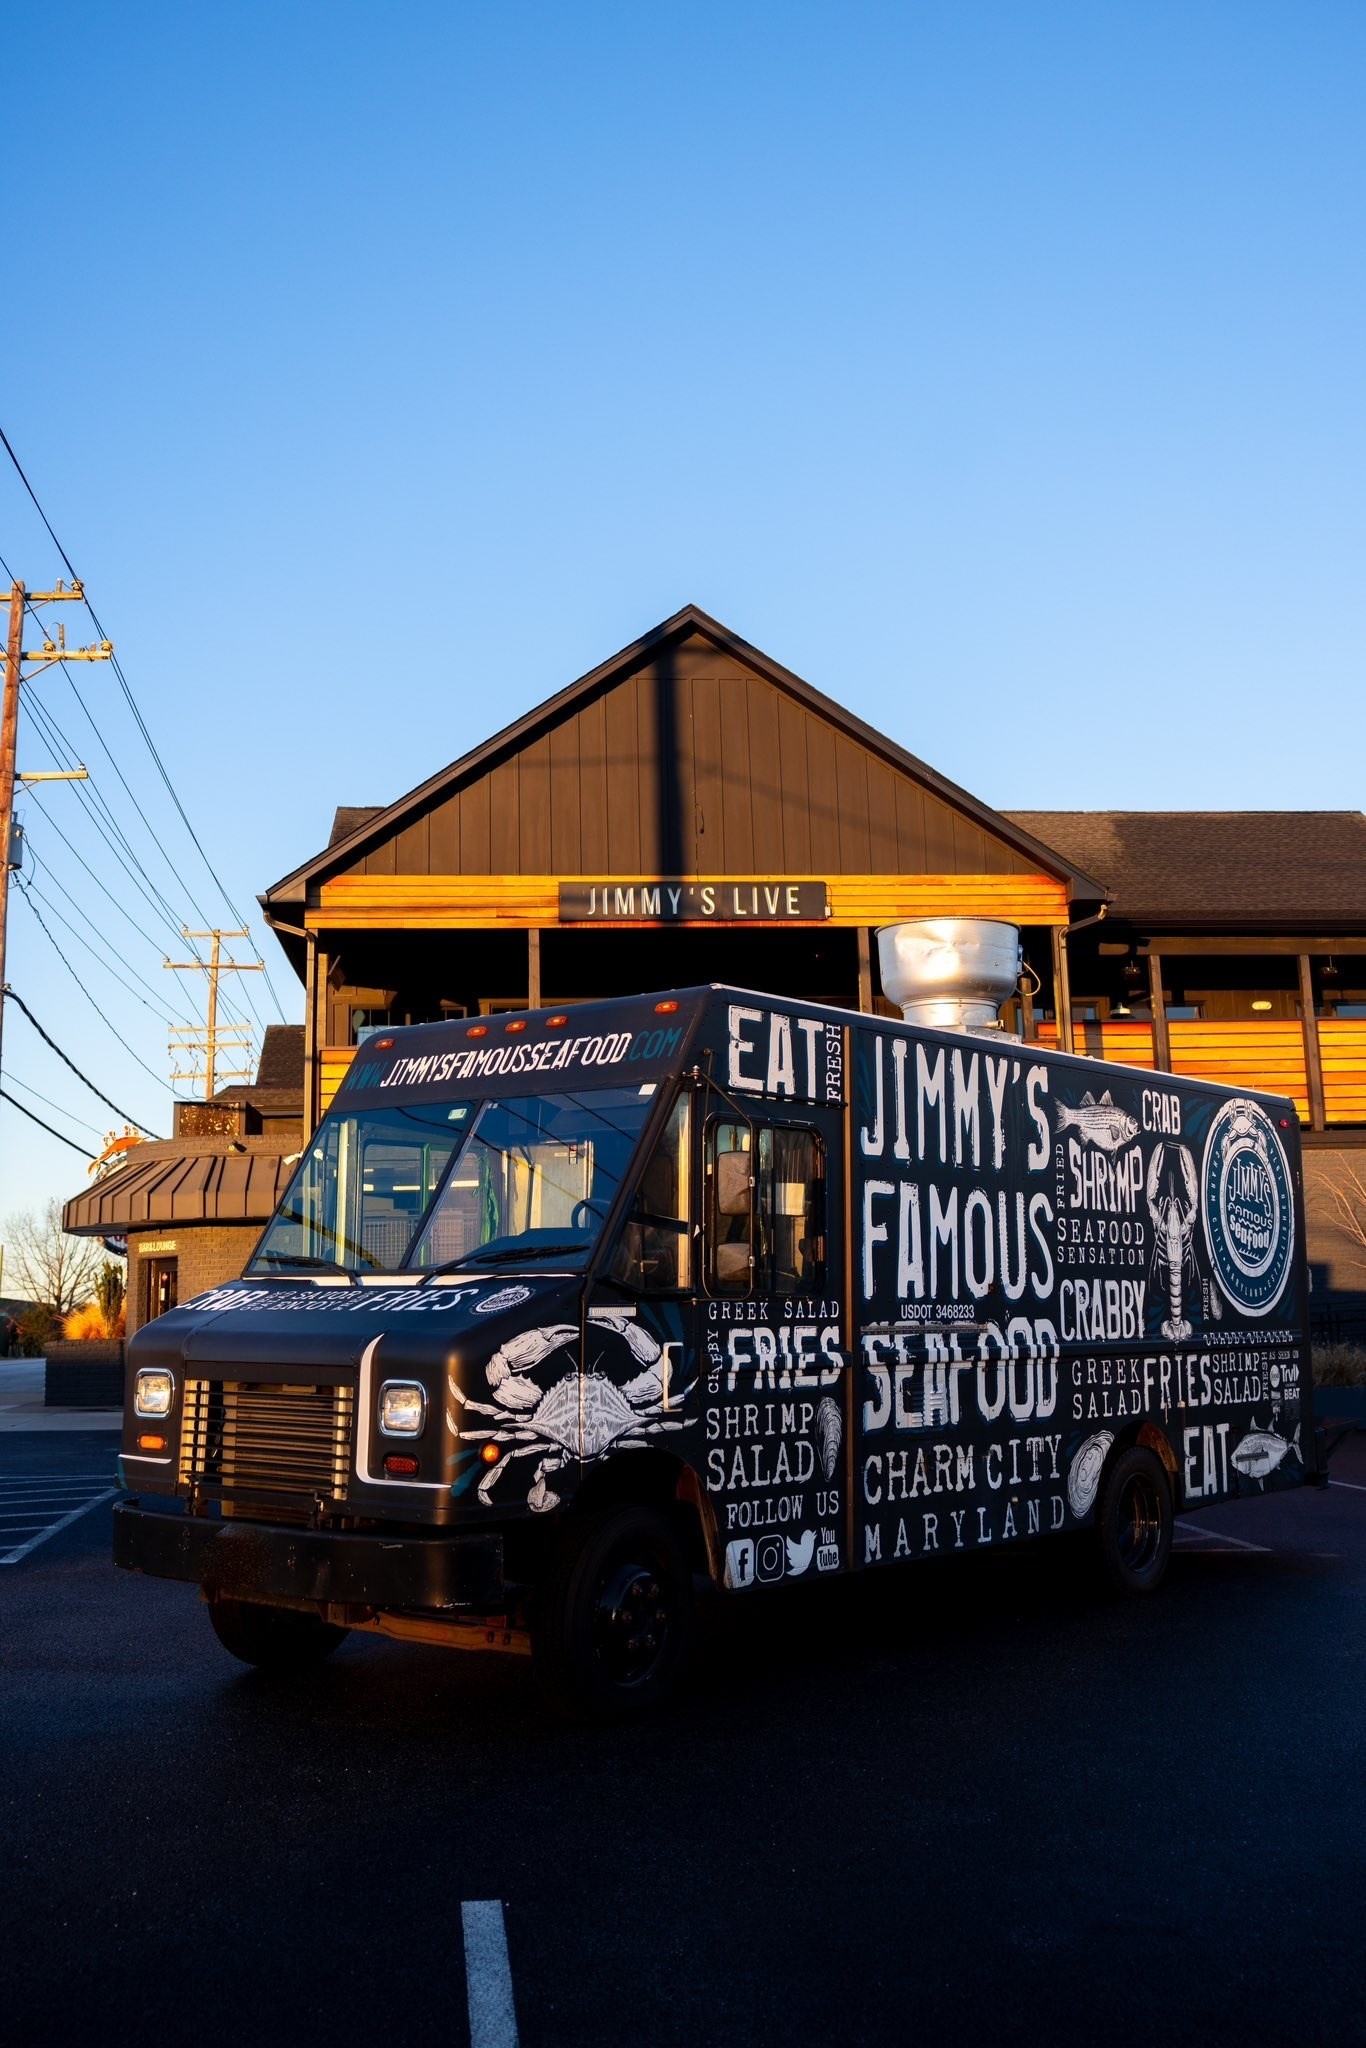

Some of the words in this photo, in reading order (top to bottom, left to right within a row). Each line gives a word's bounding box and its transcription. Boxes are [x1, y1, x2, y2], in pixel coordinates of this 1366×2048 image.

[587, 886, 716, 916] JIMMY'S
[732, 885, 801, 915] LIVE
[728, 1004, 824, 1101] EAT
[826, 1023, 842, 1102] FRESH
[860, 1035, 1050, 1173] JIMMY'S
[1142, 1089, 1181, 1136] CRAB
[1056, 1142, 1064, 1210] FRIED
[1068, 1137, 1144, 1214] SHRIMP
[1227, 1157, 1272, 1218] JIMMY'S
[861, 1179, 1055, 1300] FAMOUS
[1056, 1217, 1145, 1246] SEAFOOD
[1057, 1246, 1145, 1266] SENSATION
[174, 1289, 270, 1311] CRAB
[267, 1300, 343, 1311] ENJOY
[292, 1290, 362, 1300] SAVOR
[349, 1288, 479, 1311] FRIES
[708, 1301, 769, 1321] GREEK
[784, 1299, 840, 1320] SALAD
[901, 1304, 933, 1319] USDOT
[935, 1304, 975, 1319] 3468233
[1059, 1278, 1146, 1343] CRABBY
[727, 1325, 844, 1392] FRIES
[861, 1316, 1060, 1431] SEAFOOD
[1071, 1357, 1141, 1387] GREEK
[1212, 1351, 1260, 1374] SHRIMP
[1261, 1351, 1269, 1401] FRESH
[1143, 1354, 1212, 1413] FRIES
[1213, 1375, 1261, 1406] SALAD
[1284, 1387, 1301, 1401] BEAT
[705, 1402, 814, 1440] SHRIMP
[1072, 1389, 1142, 1420] SALAD
[706, 1440, 815, 1492] SALAD
[863, 1444, 977, 1506] CHARM
[986, 1434, 1062, 1490] CITY
[1183, 1422, 1230, 1500] EAT
[726, 1494, 804, 1530] FOLLOW
[816, 1490, 840, 1517] US
[864, 1495, 1065, 1564] MARYLAND
[820, 1526, 835, 1544] You
[817, 1550, 839, 1567] Tube
